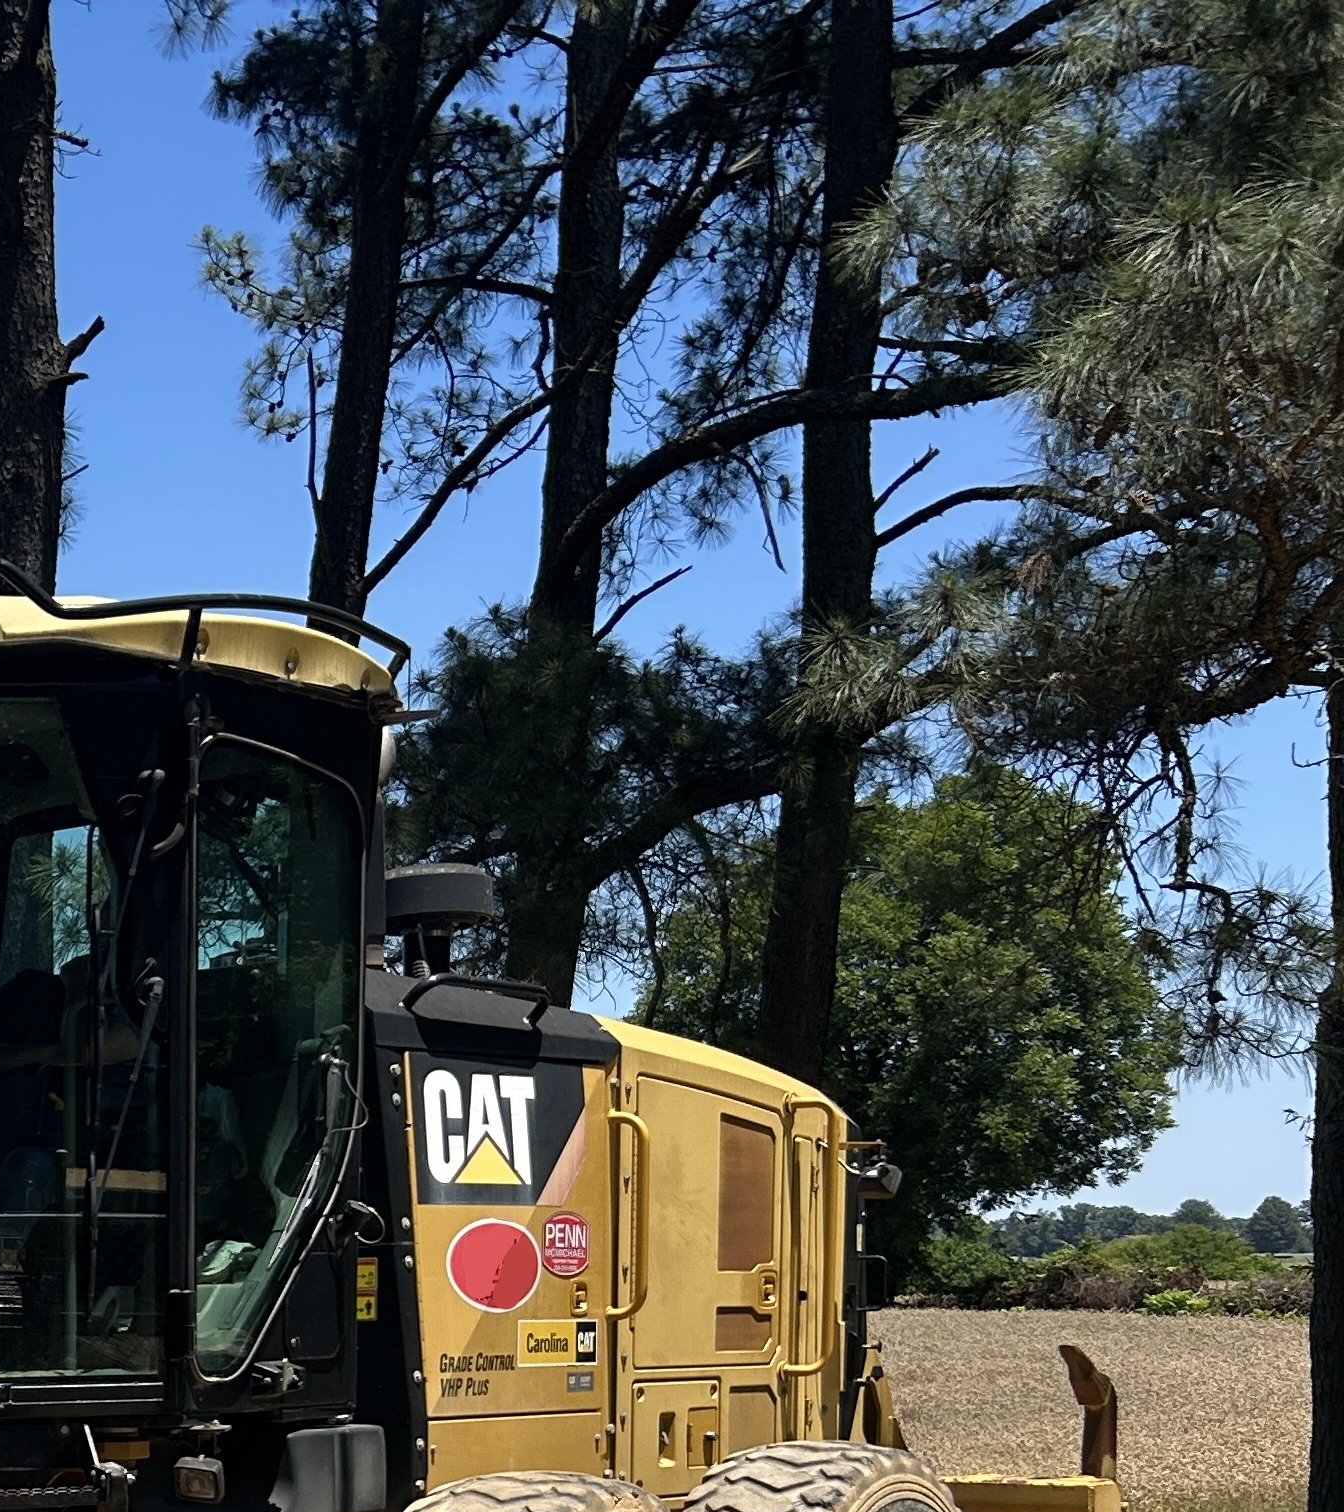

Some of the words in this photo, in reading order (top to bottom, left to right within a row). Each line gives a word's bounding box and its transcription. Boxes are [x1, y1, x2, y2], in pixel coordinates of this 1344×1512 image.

[423, 1069, 535, 1185] CAT
[545, 1223, 587, 1248] PENN
[526, 1332, 569, 1354] Carolina
[577, 1331, 596, 1353] CAT
[439, 1353, 472, 1373] GRADE
[475, 1352, 515, 1372] CONTROL
[441, 1377, 463, 1398] VHP
[465, 1377, 490, 1396] PLUS
